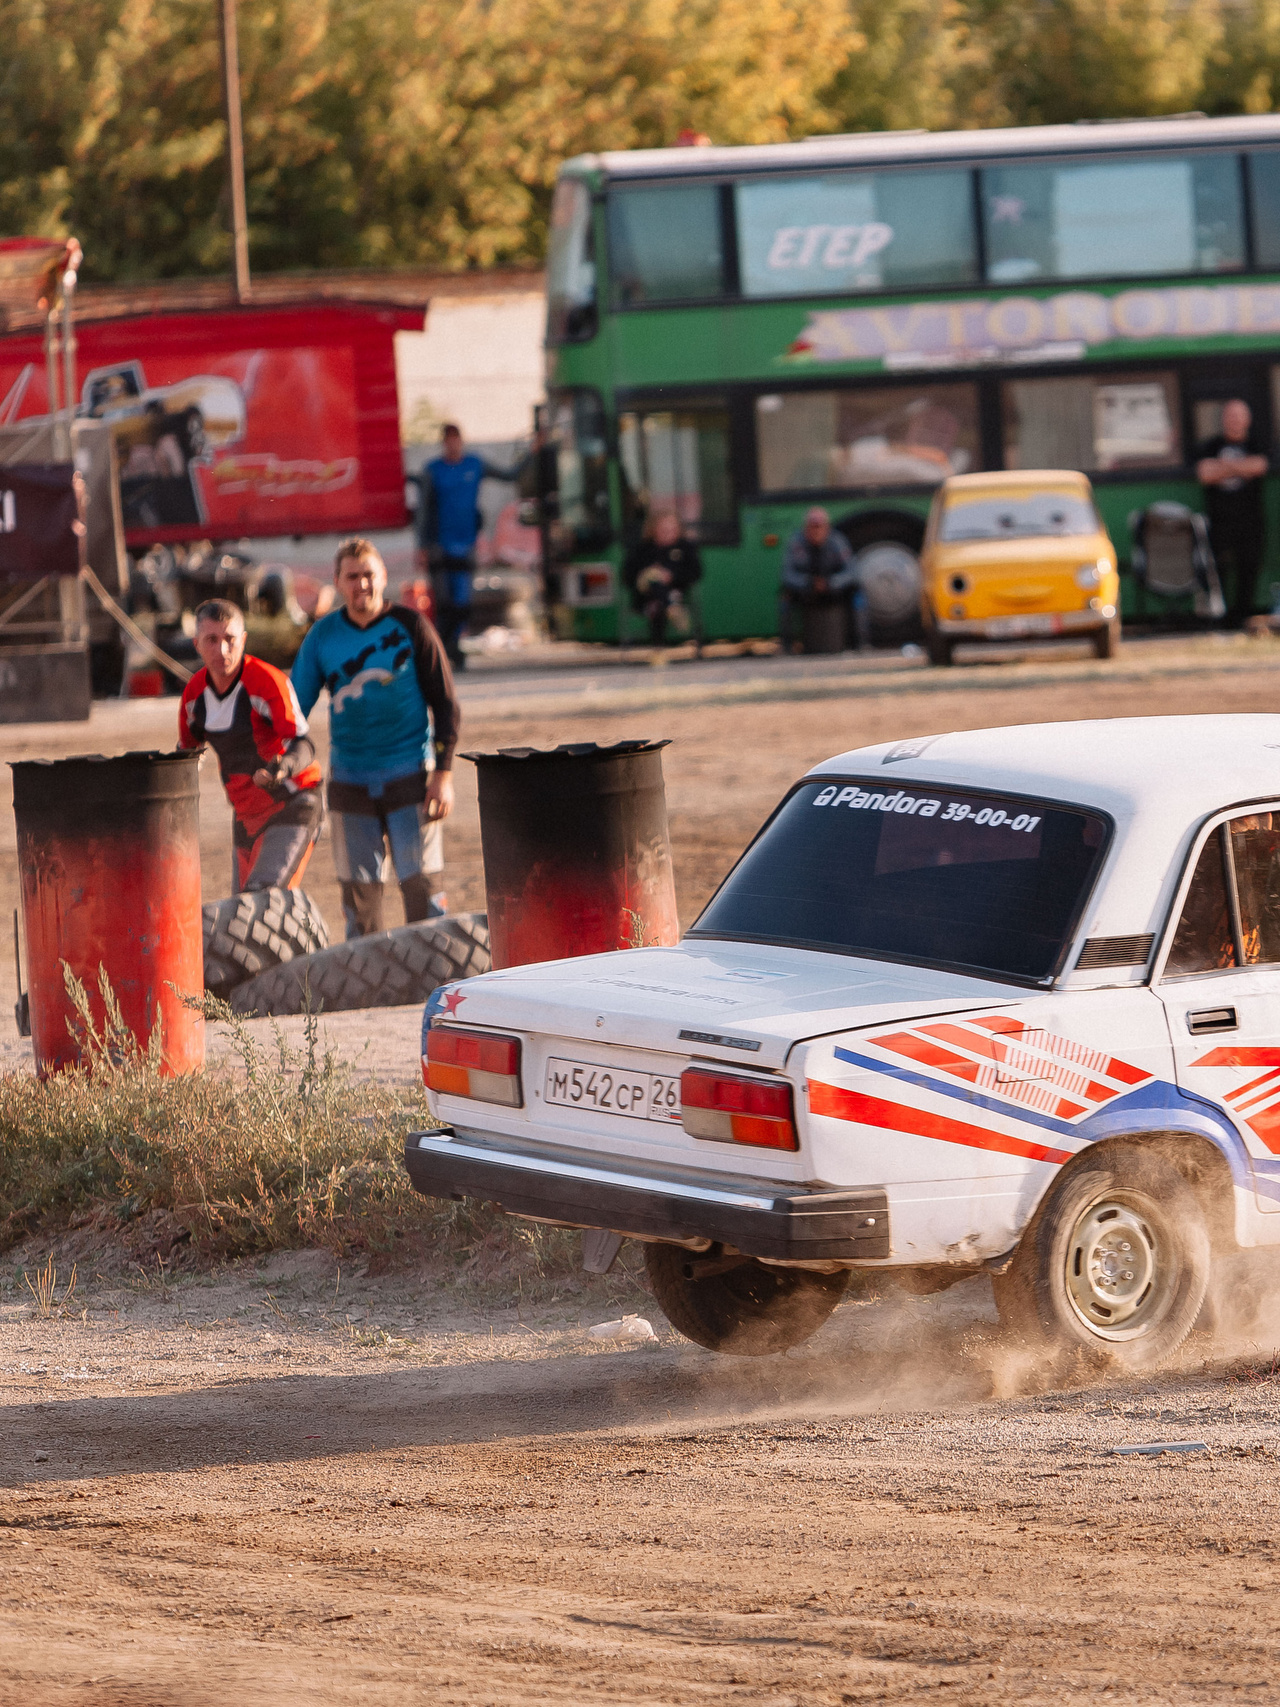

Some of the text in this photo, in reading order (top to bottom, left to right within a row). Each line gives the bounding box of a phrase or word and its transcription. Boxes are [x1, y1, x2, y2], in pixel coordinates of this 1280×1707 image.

[831, 786, 1041, 832] Pandora 39-00-01
[653, 1079, 677, 1107] 26
[651, 1105, 670, 1118] RUS
